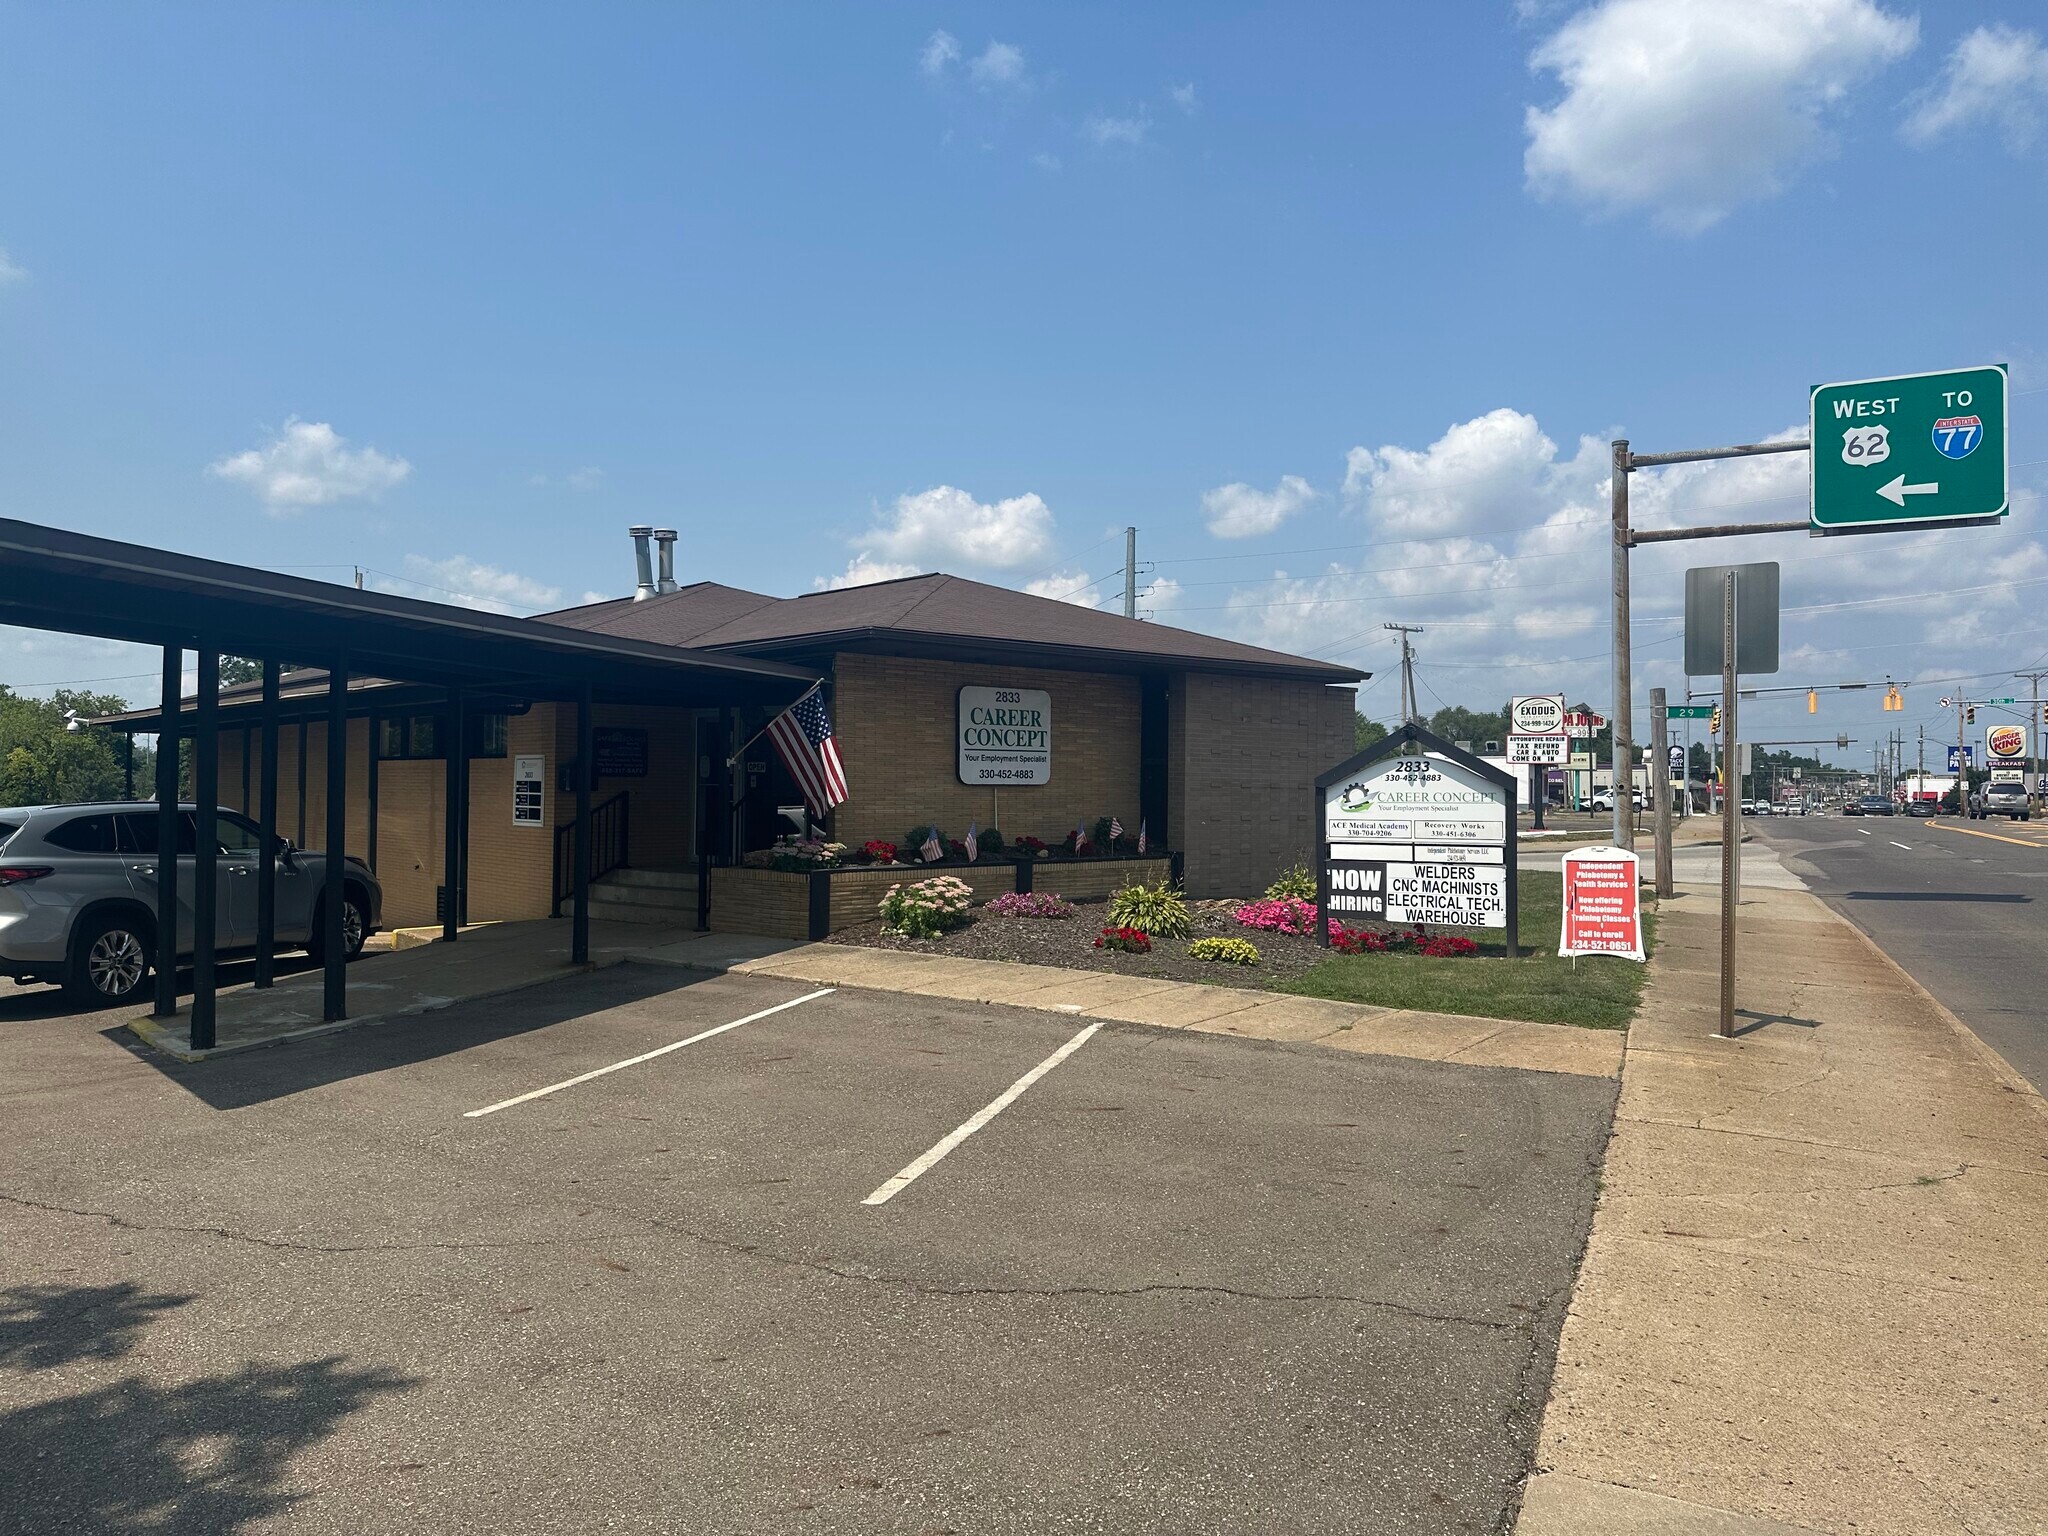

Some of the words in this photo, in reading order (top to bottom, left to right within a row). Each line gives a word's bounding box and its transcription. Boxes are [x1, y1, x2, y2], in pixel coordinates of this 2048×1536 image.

[1833, 397, 1900, 419] WEST
[1942, 390, 1973, 408] TO
[1940, 417, 1975, 427] INTERSTATE
[1938, 426, 1976, 451] 77
[1847, 433, 1885, 458] 62
[995, 691, 1021, 703] 2833
[1520, 706, 1555, 716] EXODUS
[1679, 708, 1695, 717] 29
[970, 707, 1042, 728] CAREER
[964, 727, 1048, 748] CONCEPT
[1992, 732, 2020, 744] BURGER
[1994, 737, 2022, 751] KING
[965, 754, 979, 762] Your
[981, 754, 1018, 763] Employment
[1019, 755, 1047, 763] Specialist
[1949, 760, 1972, 768] PAN
[1395, 761, 1431, 773] 2833
[979, 769, 1034, 779] 330-452-4883
[1384, 774, 1442, 782] 330-452-4883
[1377, 791, 1430, 803] CAREER
[1433, 791, 1497, 803] CONCEPT
[1430, 805, 1459, 813] Specialist
[1349, 822, 1376, 830] Medical
[1379, 823, 1409, 831] Academy
[1424, 822, 1457, 830] Recovery
[1578, 862, 1624, 871] Independent
[1414, 866, 1475, 880] WELDERS
[1576, 871, 1618, 880] Phlebotomy
[1331, 869, 1382, 891] NOW
[1392, 878, 1418, 893] CNC
[1422, 880, 1499, 896] MACHINISTS
[1330, 896, 1382, 912] HIRING
[1387, 893, 1463, 910] ELECTRICAL
[1466, 897, 1504, 912] TECH.
[1594, 897, 1623, 905] offering
[1580, 906, 1622, 914] Phlebotomy
[1405, 909, 1486, 926] WAREHOUSE
[1572, 914, 1601, 923] Training
[1601, 914, 1631, 923] Classes
[1578, 930, 1593, 938] Call
[1593, 930, 1601, 938] to
[1602, 931, 1624, 939] enroll
